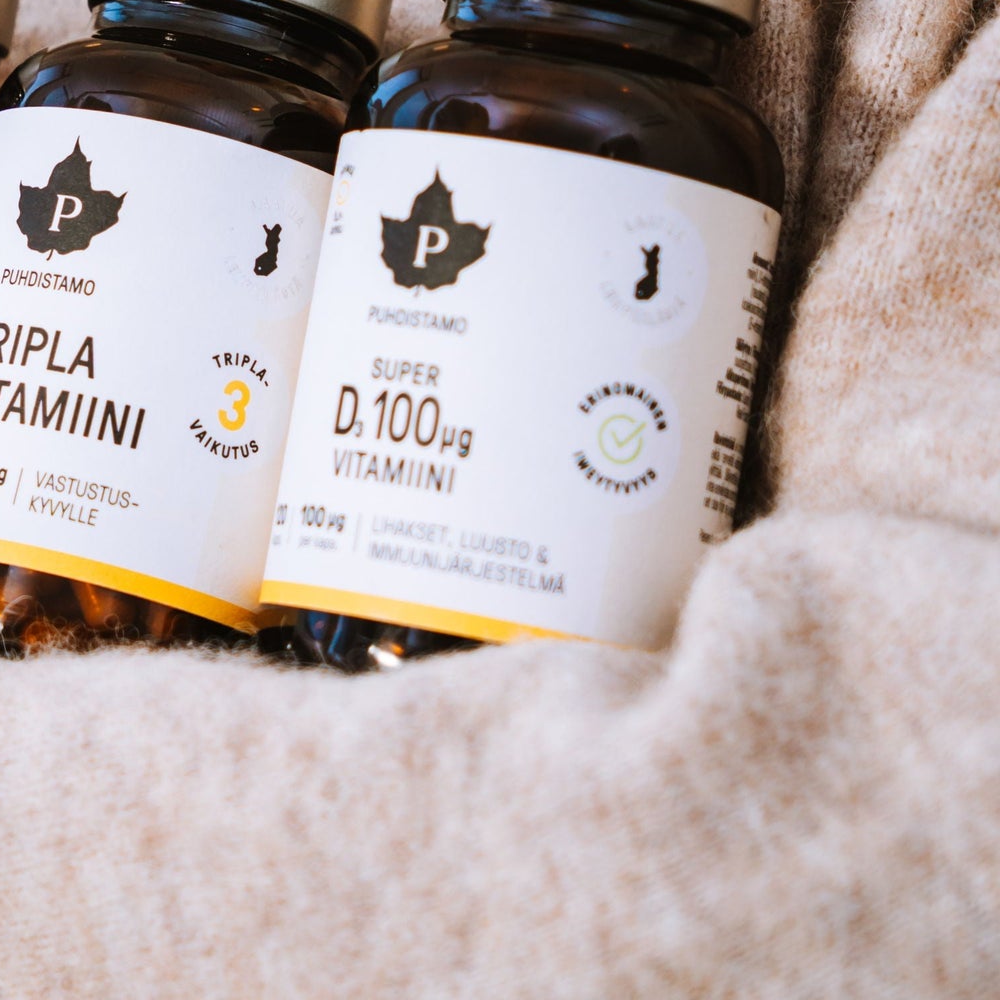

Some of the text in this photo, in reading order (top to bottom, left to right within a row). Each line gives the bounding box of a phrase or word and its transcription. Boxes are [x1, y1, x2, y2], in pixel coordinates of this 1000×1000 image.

[50, 194, 83, 232] P
[413, 225, 450, 268] P
[1, 268, 95, 296] PUHDISTAMO
[368, 305, 468, 336] PUHDISTAMO
[212, 351, 270, 389] TRIPLA-
[371, 357, 440, 388] SUPER
[218, 380, 251, 431] 3
[189, 418, 259, 460] VAIKUTUS
[35, 470, 139, 509] VASTUSTUS-
[332, 448, 456, 495] VITAMIINI
[28, 495, 99, 527] KYVYLLE
[302, 504, 325, 527] 100
[460, 530, 530, 560] LUUSTO
[537, 545, 549, 564] &
